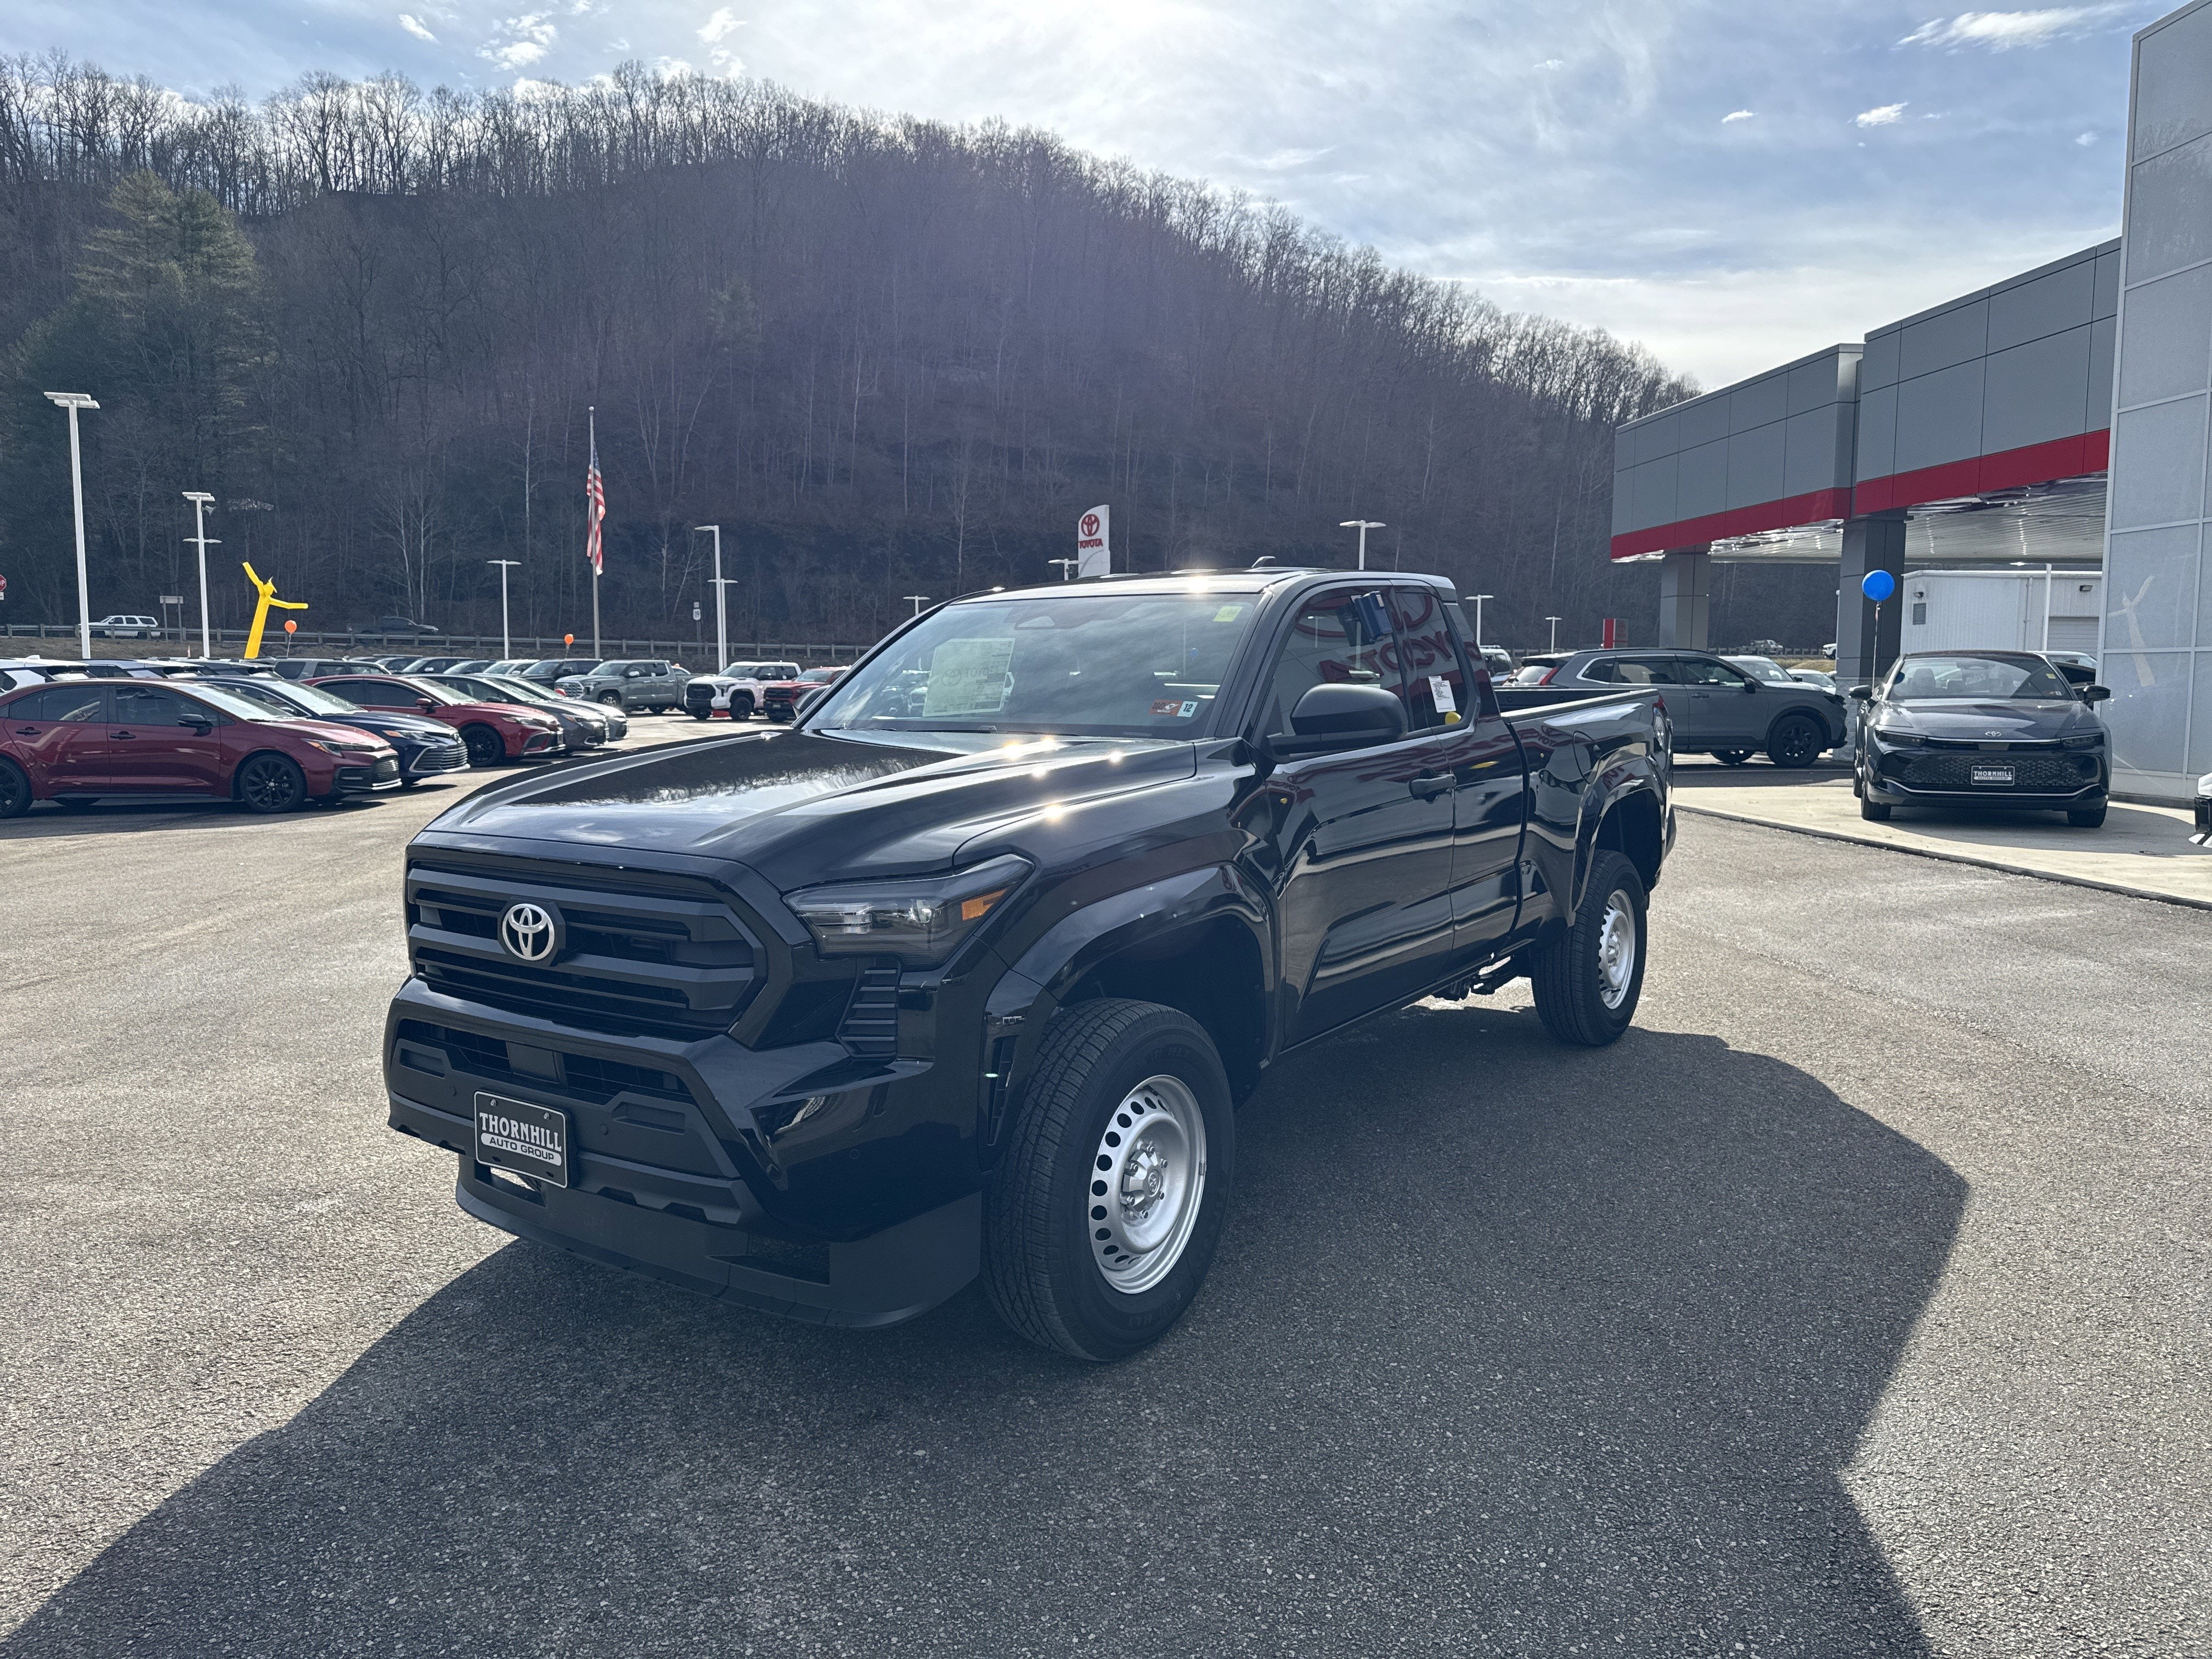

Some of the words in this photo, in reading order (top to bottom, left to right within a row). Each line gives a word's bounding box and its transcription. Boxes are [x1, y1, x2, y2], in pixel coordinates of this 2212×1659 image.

[1079, 538, 1103, 549] TOYOTA
[1183, 703, 1193, 712] 12
[479, 1113, 562, 1152] THORNHILL
[489, 1137, 517, 1150] AUTO
[521, 1144, 554, 1161] GROUP
